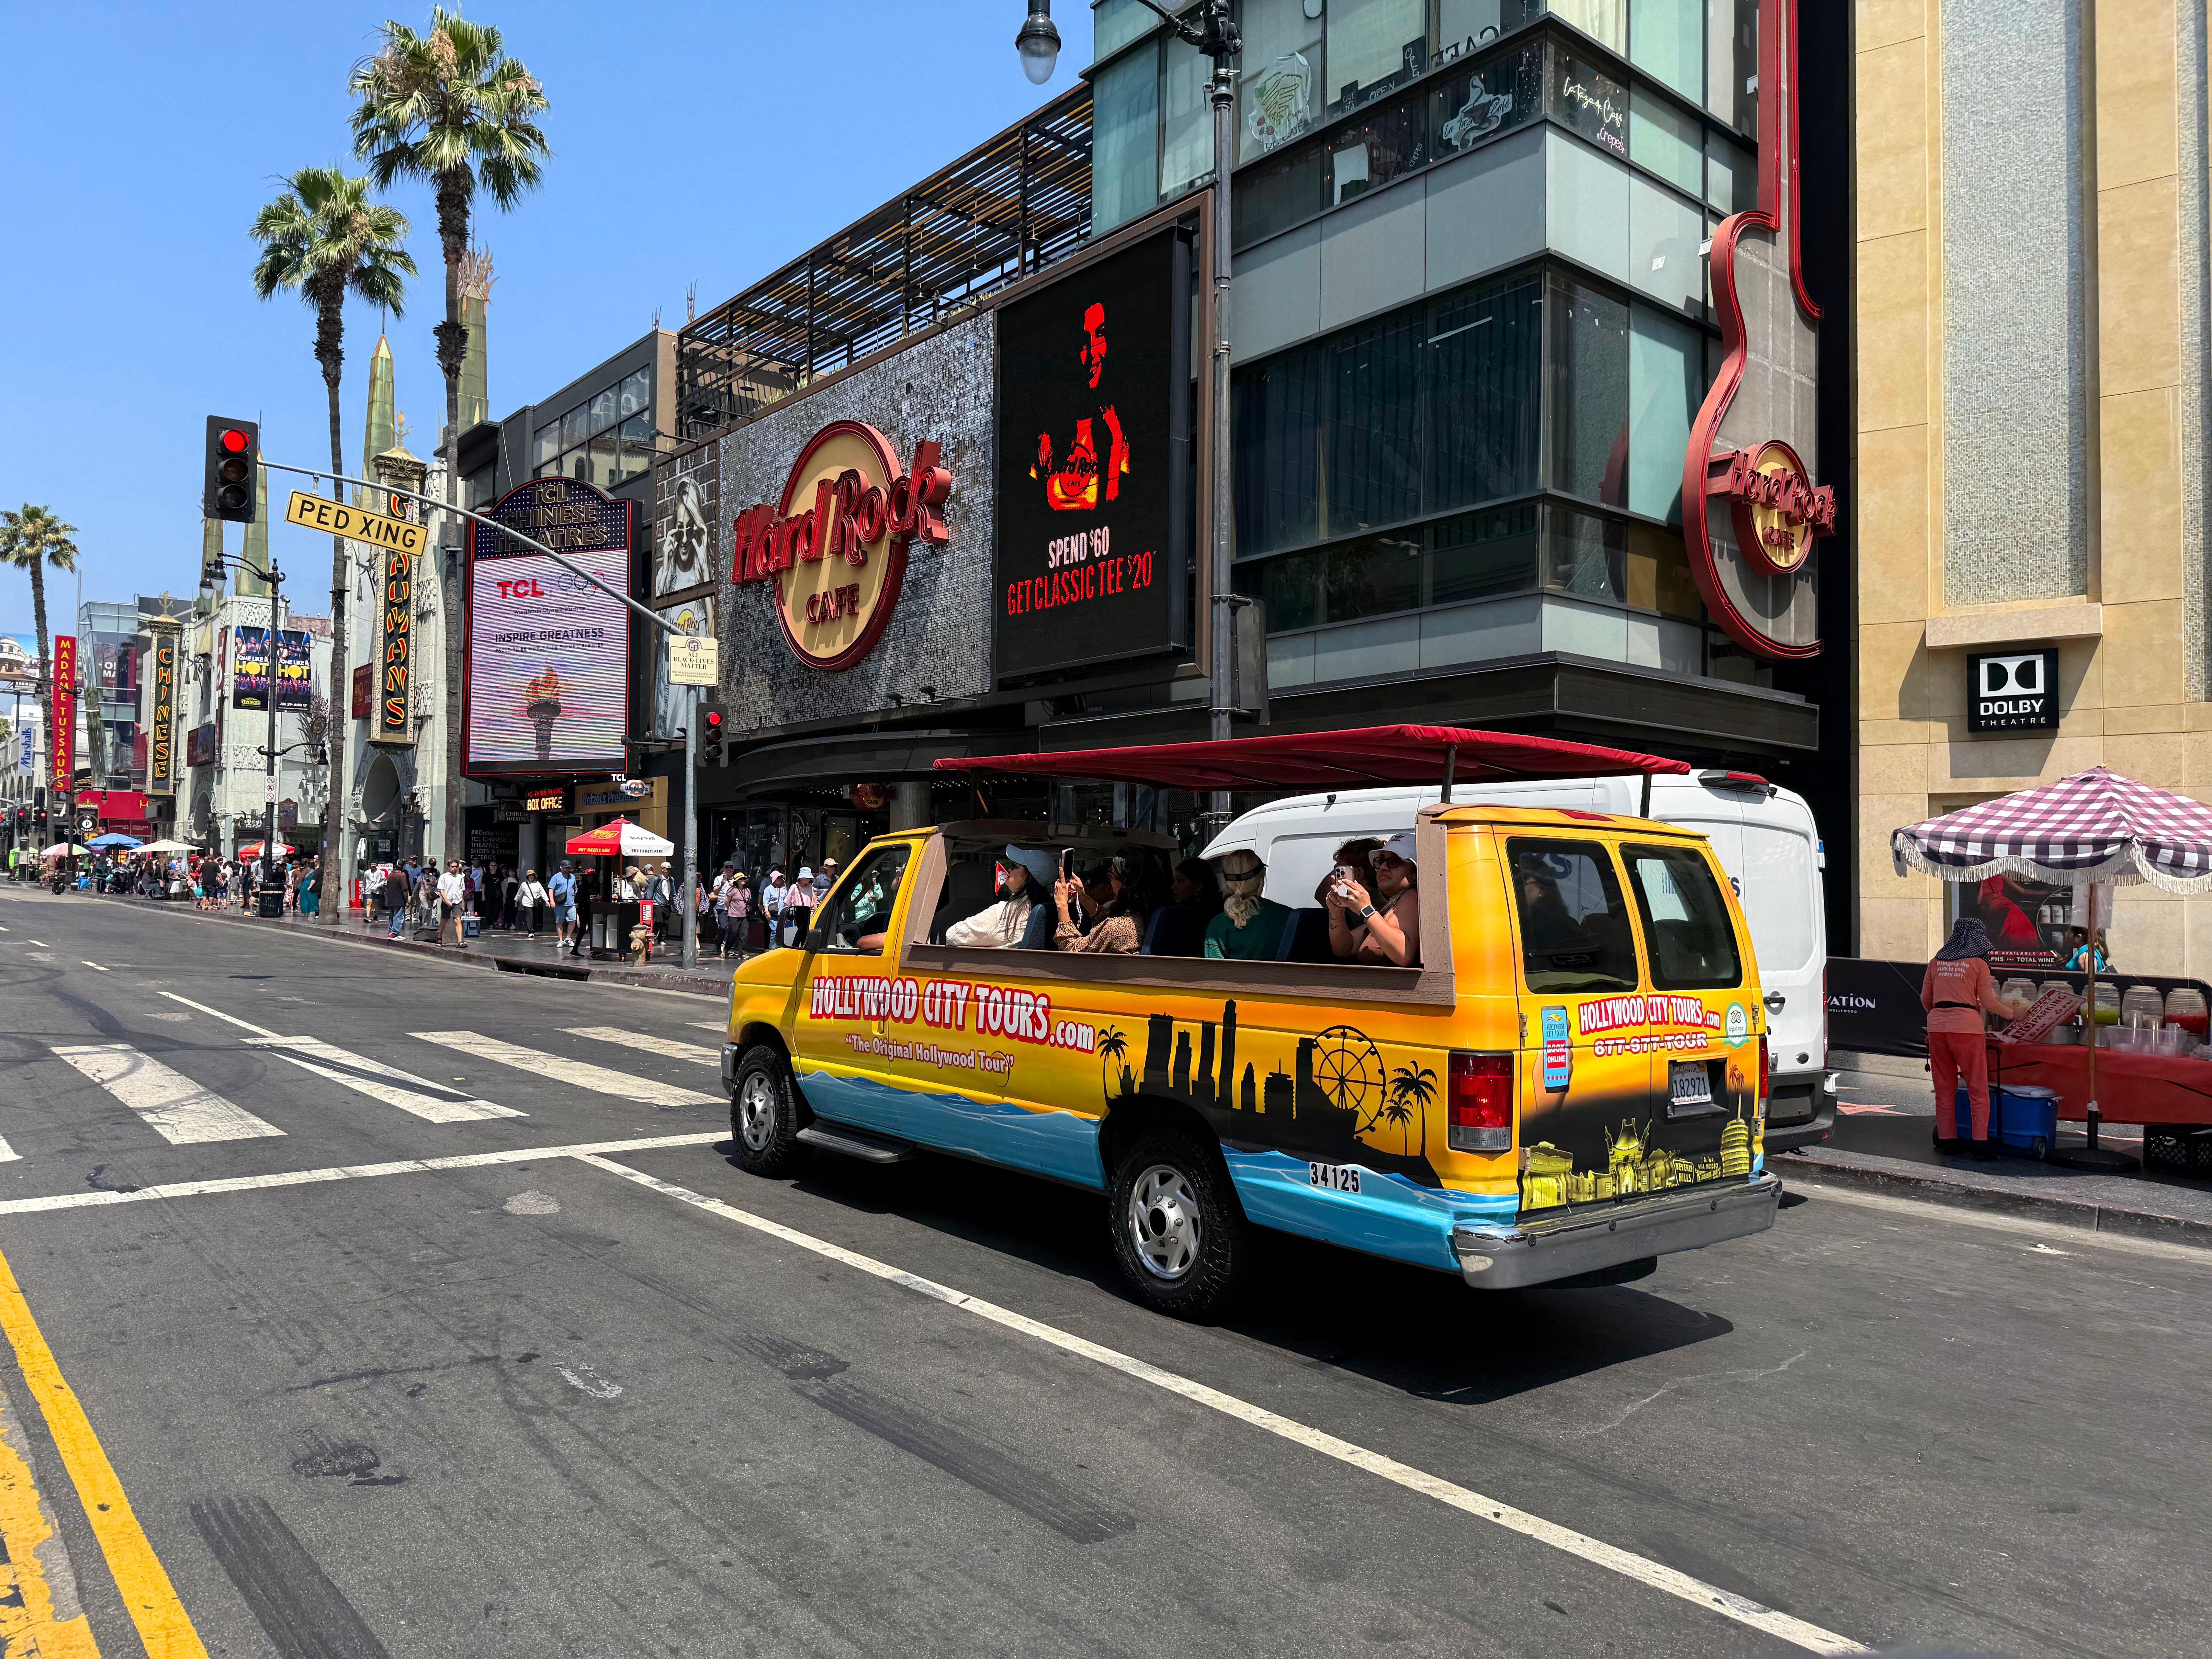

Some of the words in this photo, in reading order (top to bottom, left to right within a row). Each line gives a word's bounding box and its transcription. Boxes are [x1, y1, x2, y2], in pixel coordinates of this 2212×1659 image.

[1405, 47, 1423, 77] OPE
[1343, 90, 1355, 102] CAFE
[1345, 103, 1355, 112] TEA
[1600, 127, 1623, 150] Crepes
[527, 484, 570, 505] TCL
[1788, 471, 1838, 536] Rock
[299, 500, 350, 530] PED
[362, 516, 417, 548] XING
[500, 503, 597, 528] CHINESE
[732, 477, 833, 585] Hard
[830, 441, 951, 567] Rock
[1048, 532, 1087, 568] SPEND
[1089, 526, 1110, 557] $60
[496, 579, 544, 599] TCL
[1007, 579, 1032, 616] GET
[1034, 565, 1095, 610] CLASSIC
[1098, 558, 1124, 596] TEE
[386, 493, 410, 726] GAUMANS
[805, 583, 859, 624] CAFE
[495, 632, 536, 642] INSPIRE
[540, 627, 604, 640] GREATNESS
[58, 640, 70, 701] MADAME
[235, 660, 269, 676] HOT
[278, 664, 310, 678] HOT
[155, 648, 172, 778] CHINESE
[1980, 699, 2044, 716] DOLBY
[1980, 717, 2046, 726] THEATRE
[21, 727, 32, 768] Marshalls
[57, 707, 67, 788] TUSSAUDS
[527, 799, 539, 811] BOX
[541, 797, 562, 809] OFFICE
[795, 822, 810, 837] Rock
[810, 976, 919, 1024] HOLLYWOOD
[923, 979, 970, 1030] CITY
[1579, 996, 1645, 1034] HOLLYWOOD
[1647, 995, 1669, 1024] CITY
[2033, 994, 2066, 1024] PARKING
[873, 1037, 913, 1061] Original
[915, 1041, 975, 1069] Hollywood
[1547, 1043, 1565, 1053] BOOK
[1547, 1055, 1566, 1063] ONLINE
[1310, 1163, 1359, 1192] 34125
[1679, 1173, 1692, 1182] HILLS
